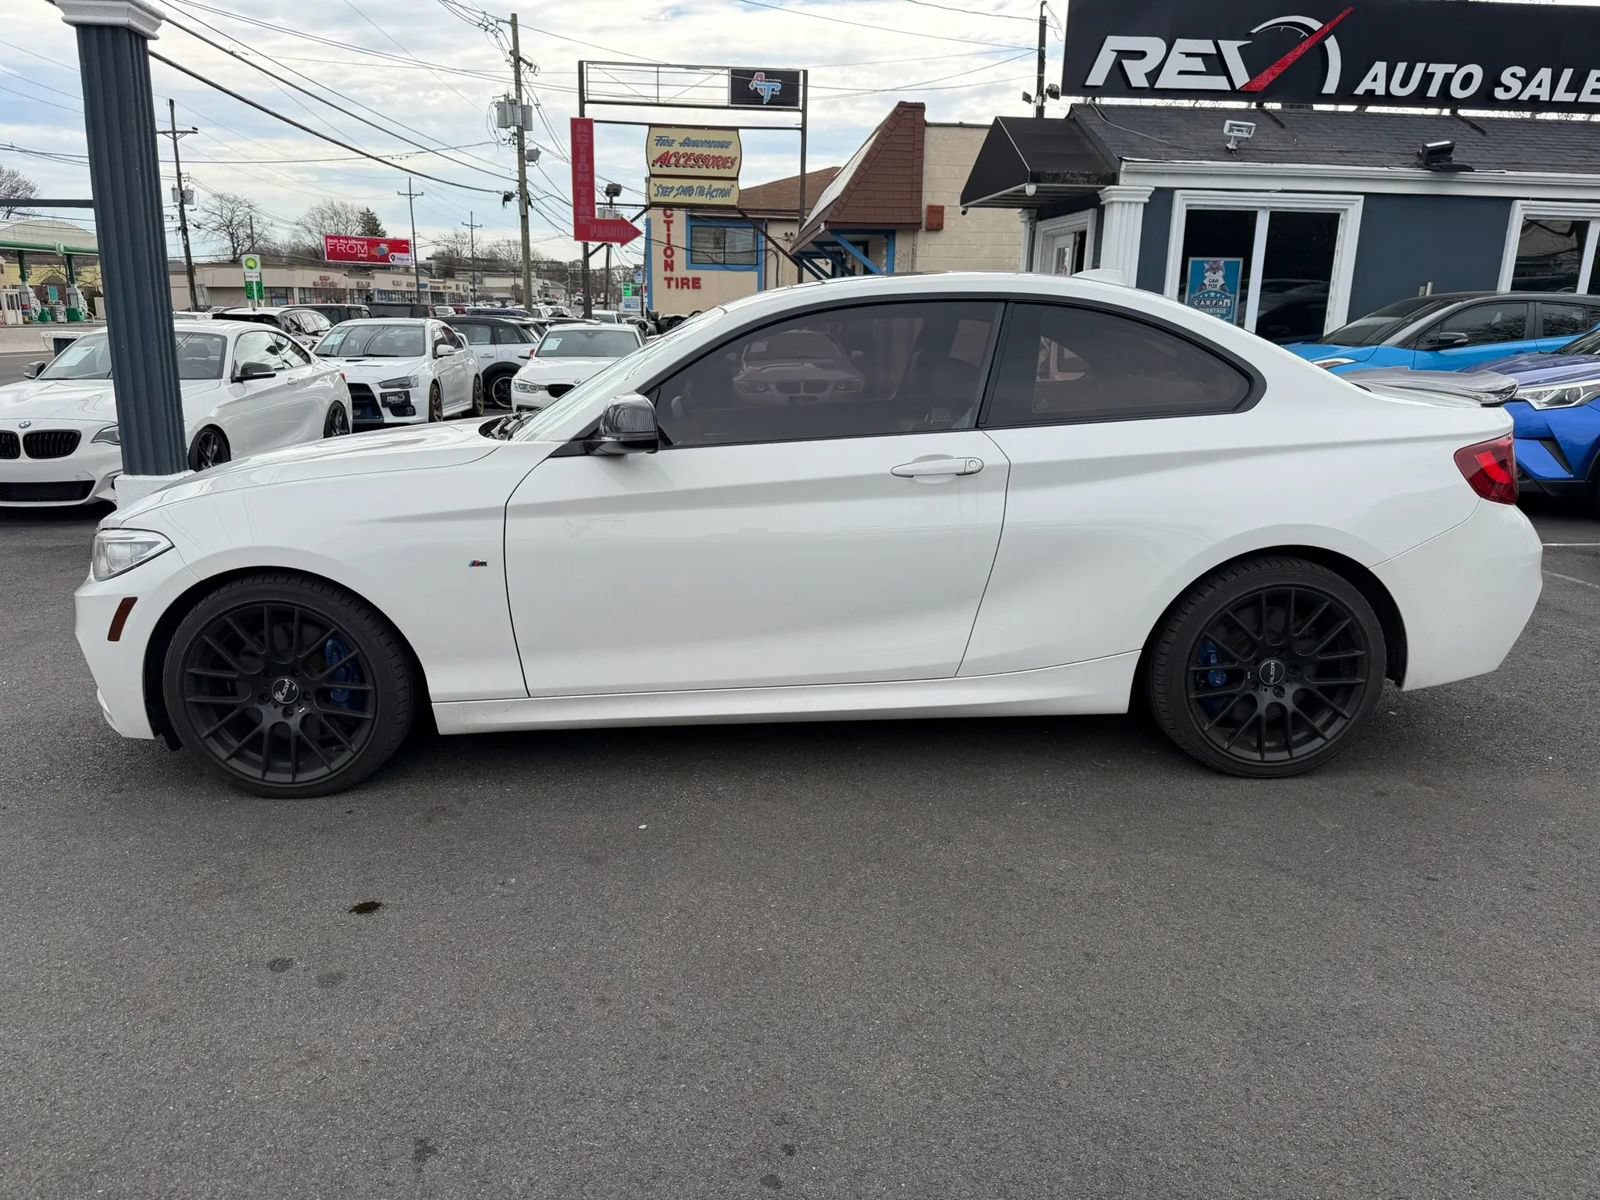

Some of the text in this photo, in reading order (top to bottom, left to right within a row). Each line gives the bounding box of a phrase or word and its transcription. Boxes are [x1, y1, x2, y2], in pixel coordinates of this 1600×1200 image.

[1353, 61, 1484, 99] AUTO
[652, 150, 738, 170] ACCESSORIES
[327, 243, 368, 255] FROM
[664, 277, 701, 290] TIRE
